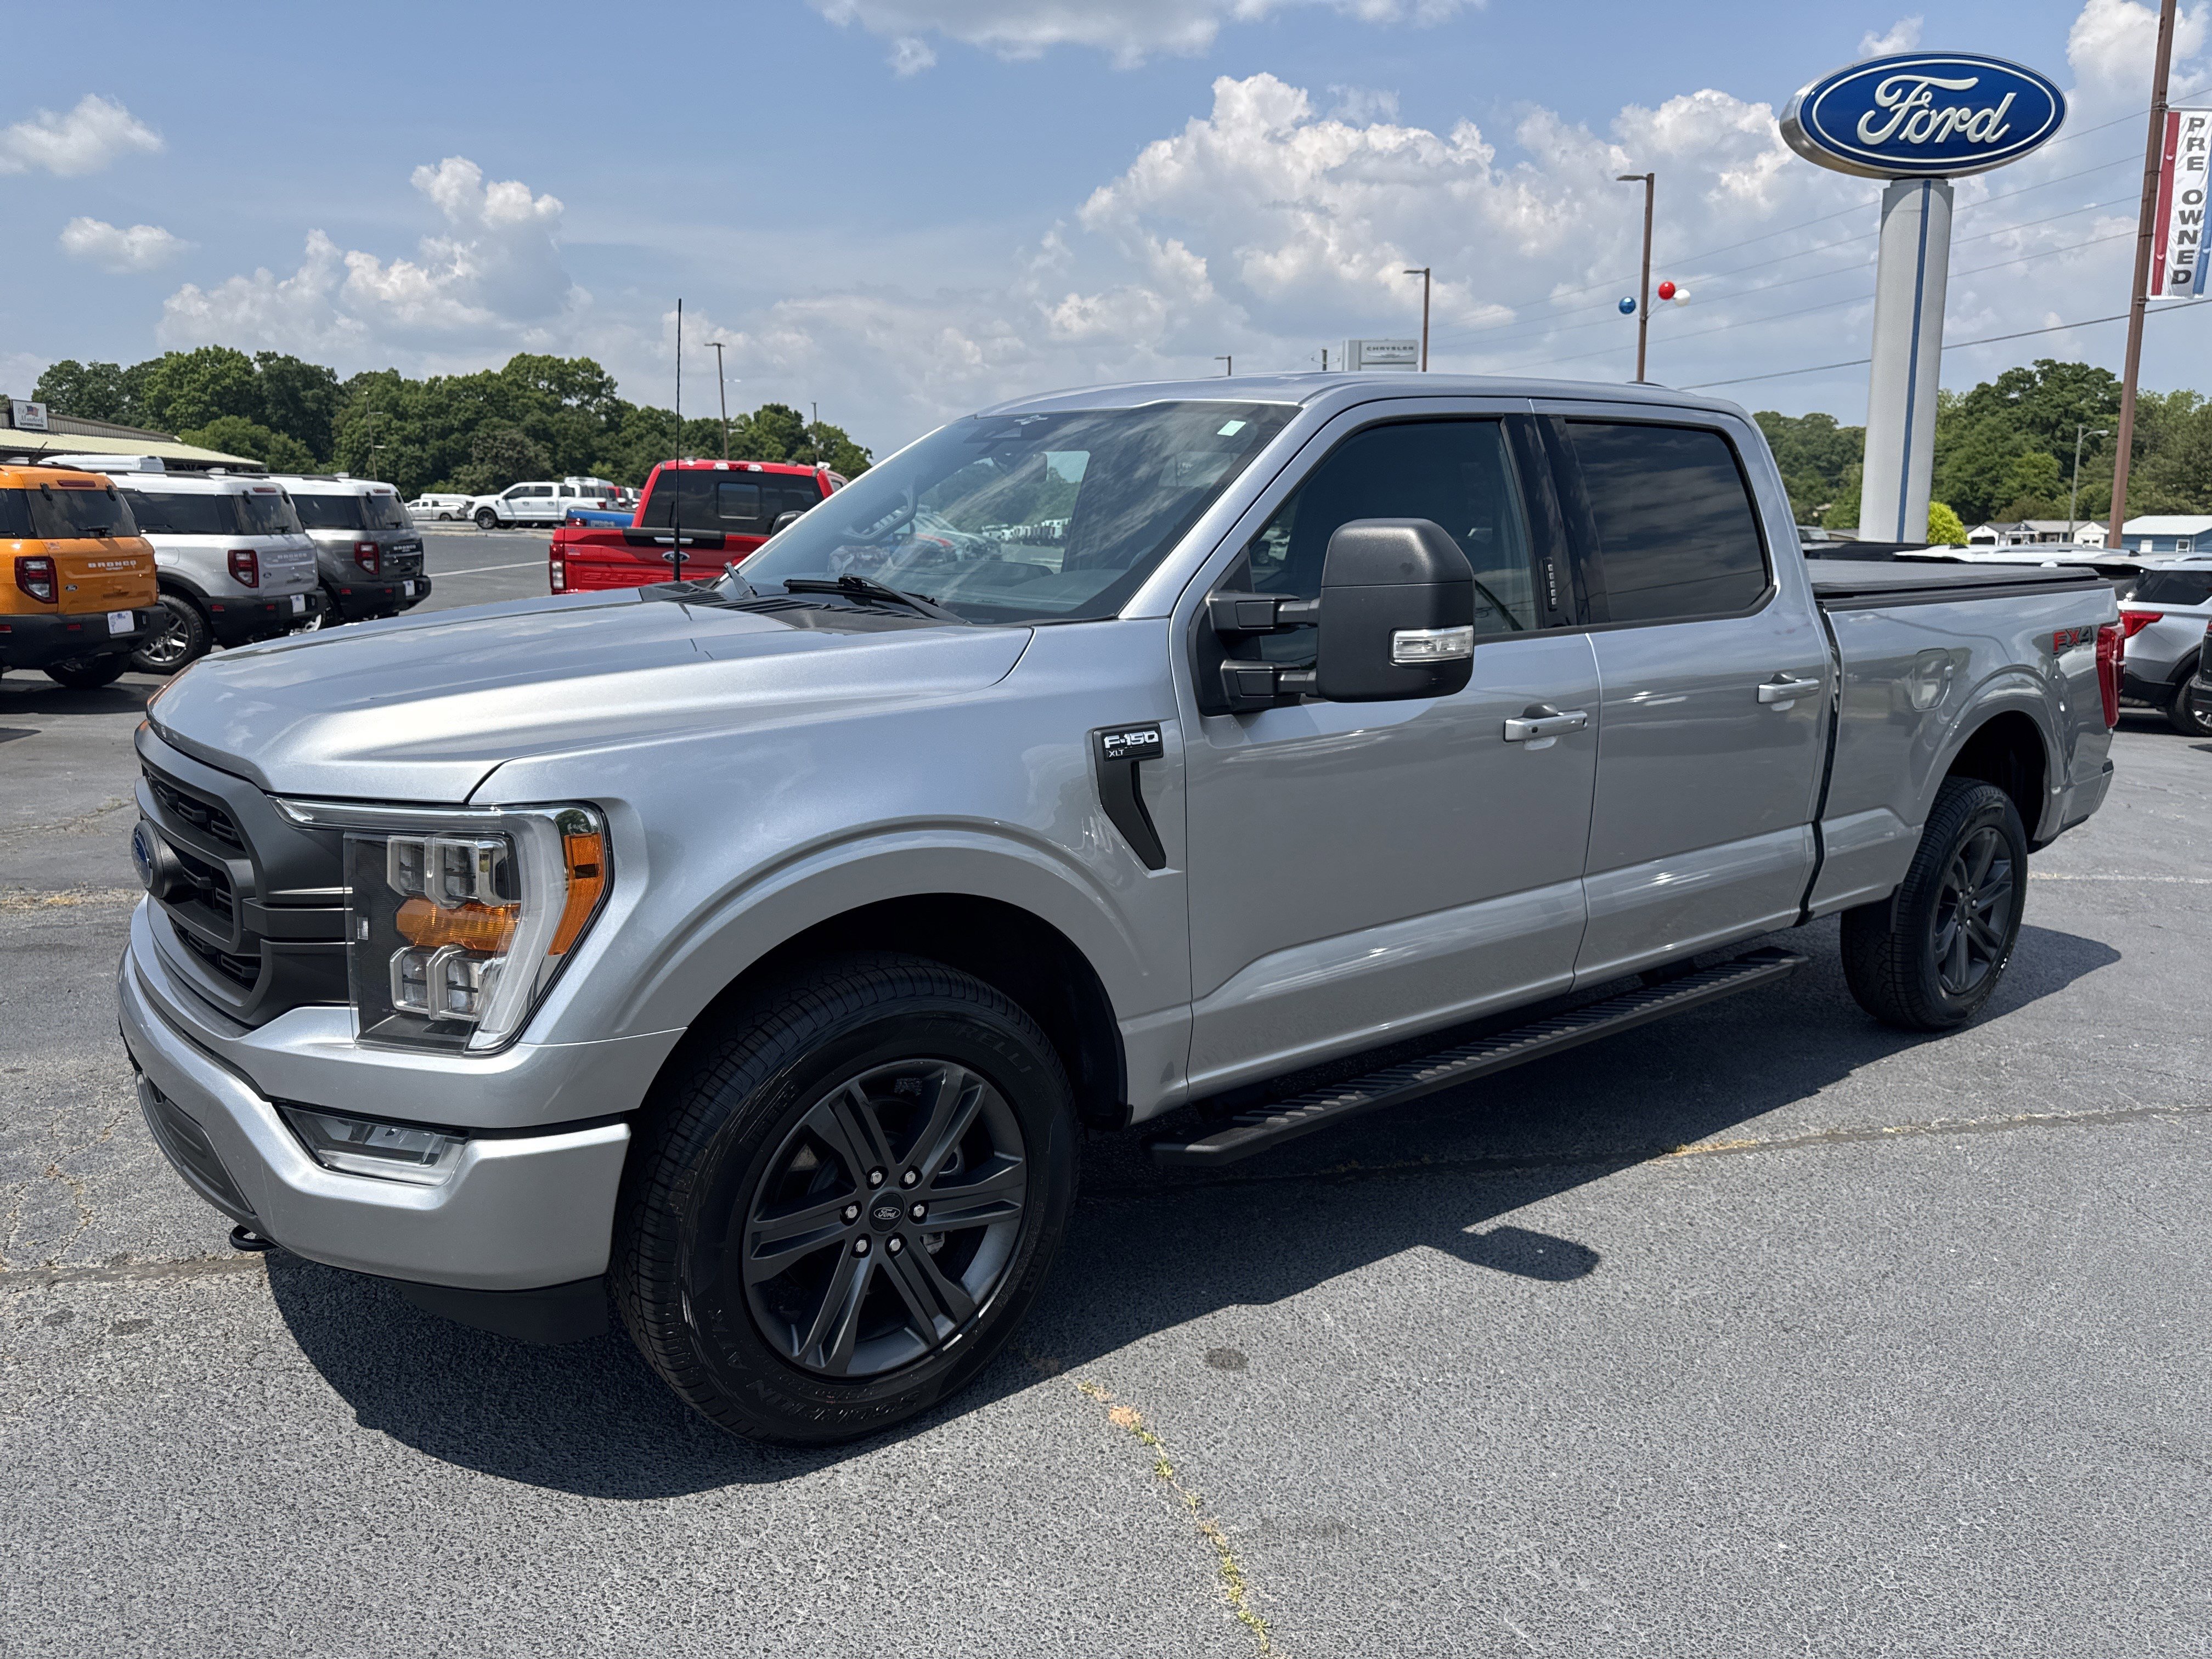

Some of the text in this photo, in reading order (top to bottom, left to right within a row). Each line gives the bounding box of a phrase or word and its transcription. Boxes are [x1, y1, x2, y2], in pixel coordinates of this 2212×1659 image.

[1857, 75, 2017, 145] Ford
[2170, 117, 2205, 285] PRE OWNED
[88, 560, 137, 568] BRONCO
[2053, 626, 2093, 654] FX4
[1104, 730, 1159, 748] F-150
[1109, 749, 1124, 758] XLT
[878, 1209, 896, 1217] Ford
